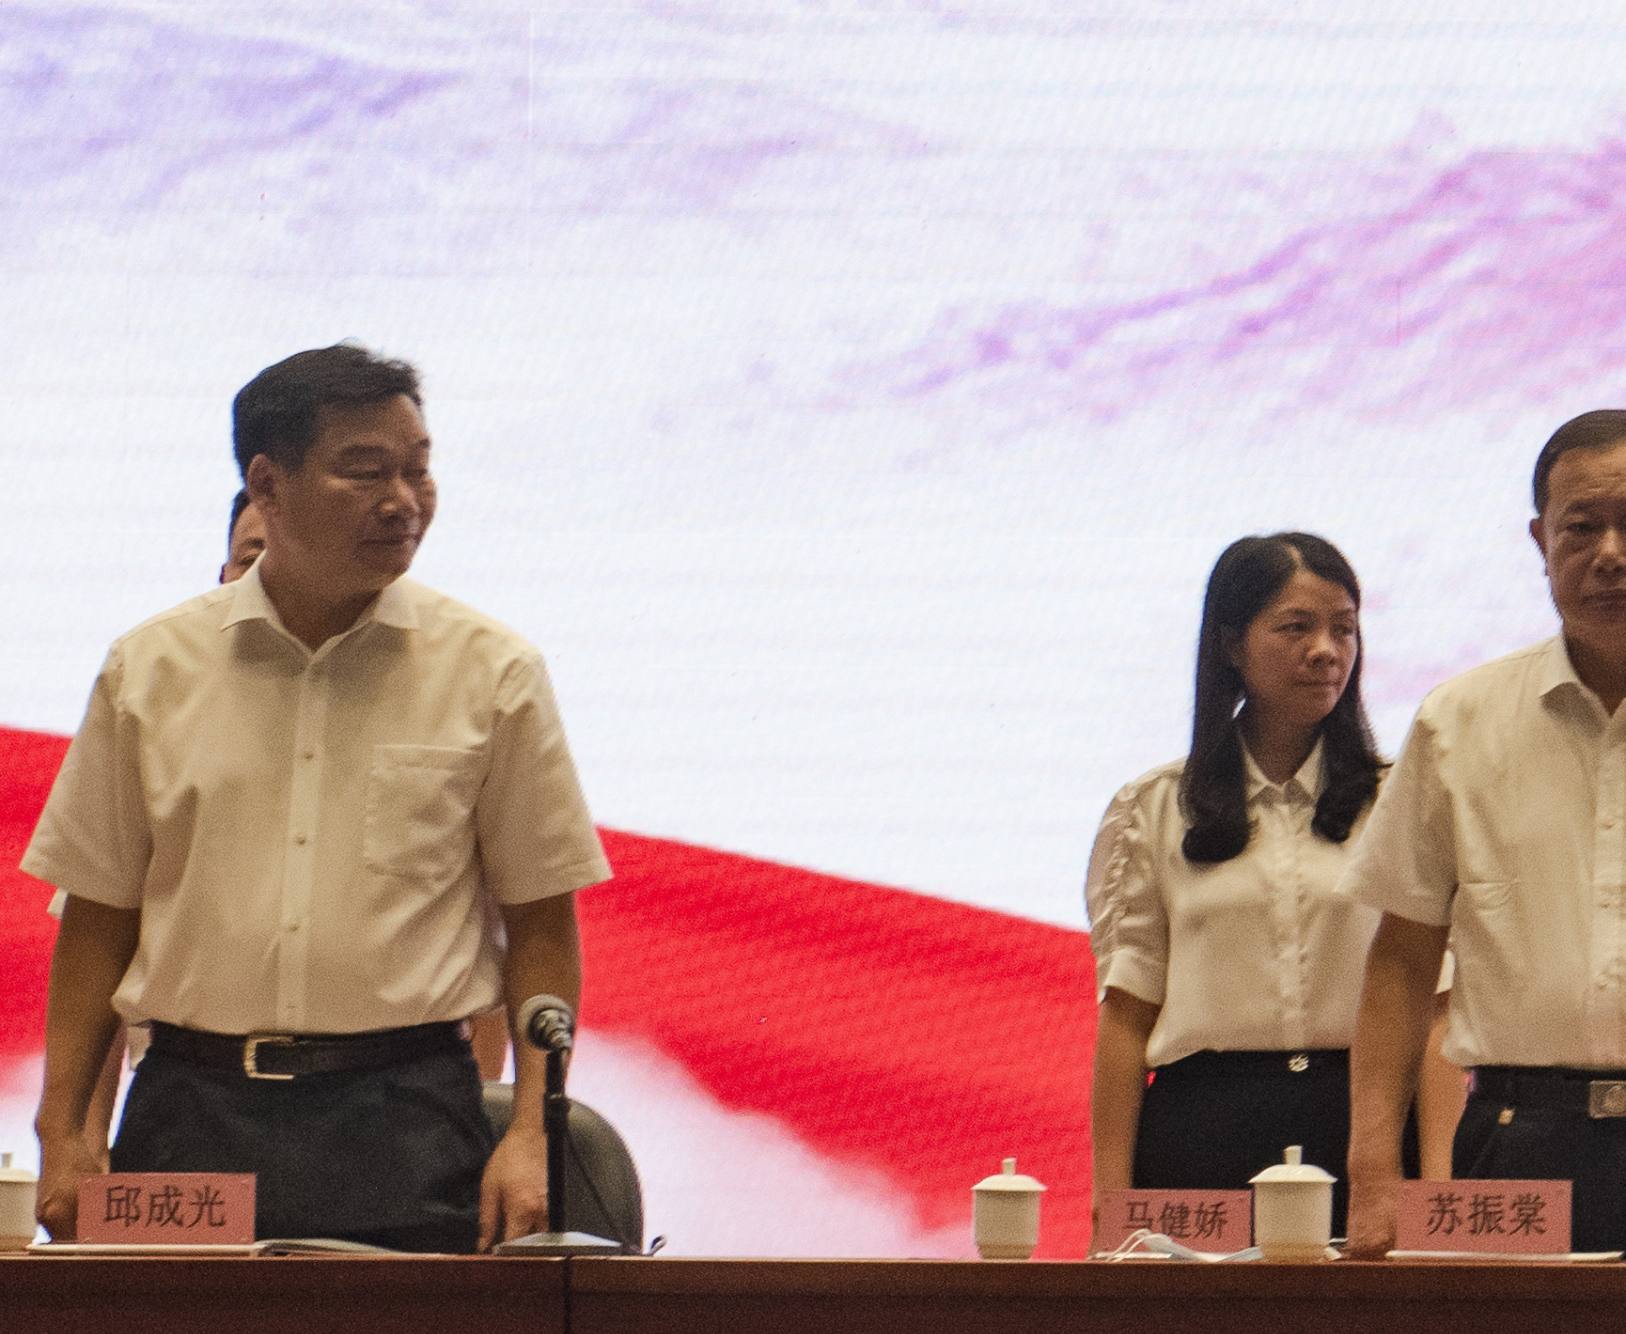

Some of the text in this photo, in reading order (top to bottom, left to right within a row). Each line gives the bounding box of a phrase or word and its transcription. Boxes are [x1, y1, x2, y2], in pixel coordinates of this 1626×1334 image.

[102, 1183, 226, 1228] 邱成光
[1122, 1200, 1228, 1240] 马健娇
[1426, 1191, 1549, 1237] 苏振棠
